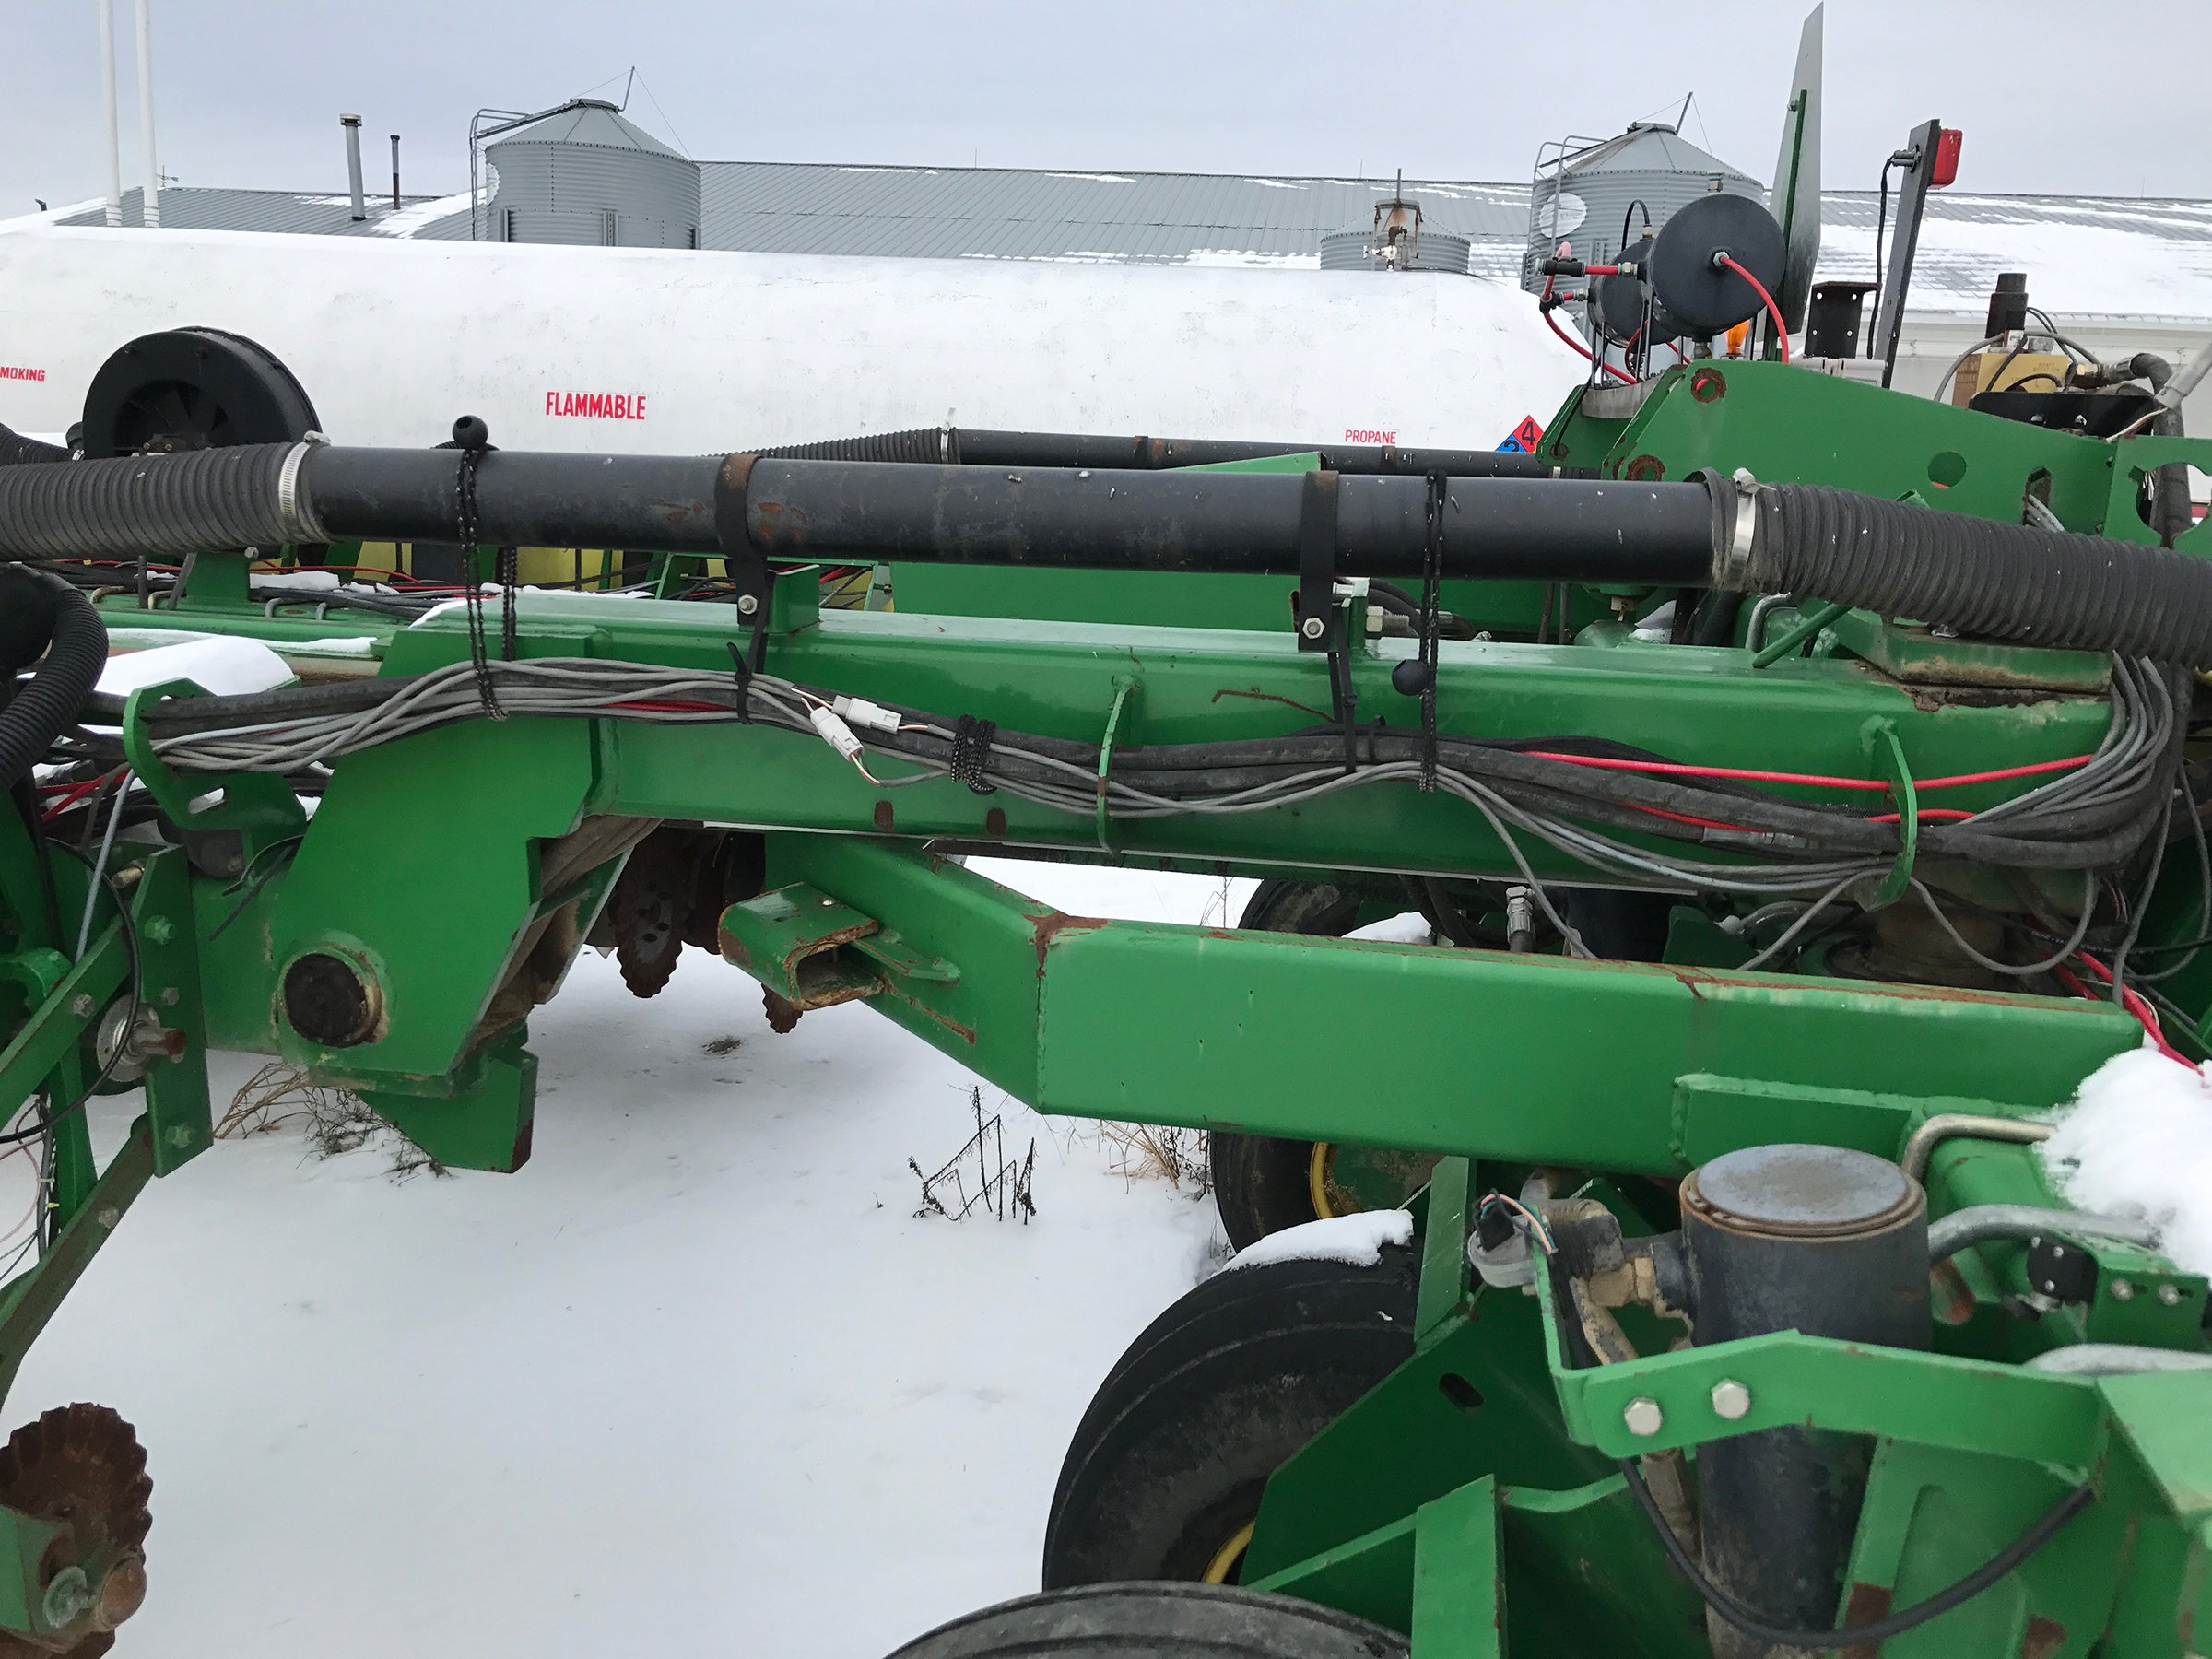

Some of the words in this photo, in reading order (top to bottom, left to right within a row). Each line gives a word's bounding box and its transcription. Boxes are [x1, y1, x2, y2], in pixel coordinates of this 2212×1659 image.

[546, 391, 646, 420] FLAMMABLE
[1345, 429, 1397, 444] PROPANE
[1521, 420, 1535, 446] 4
